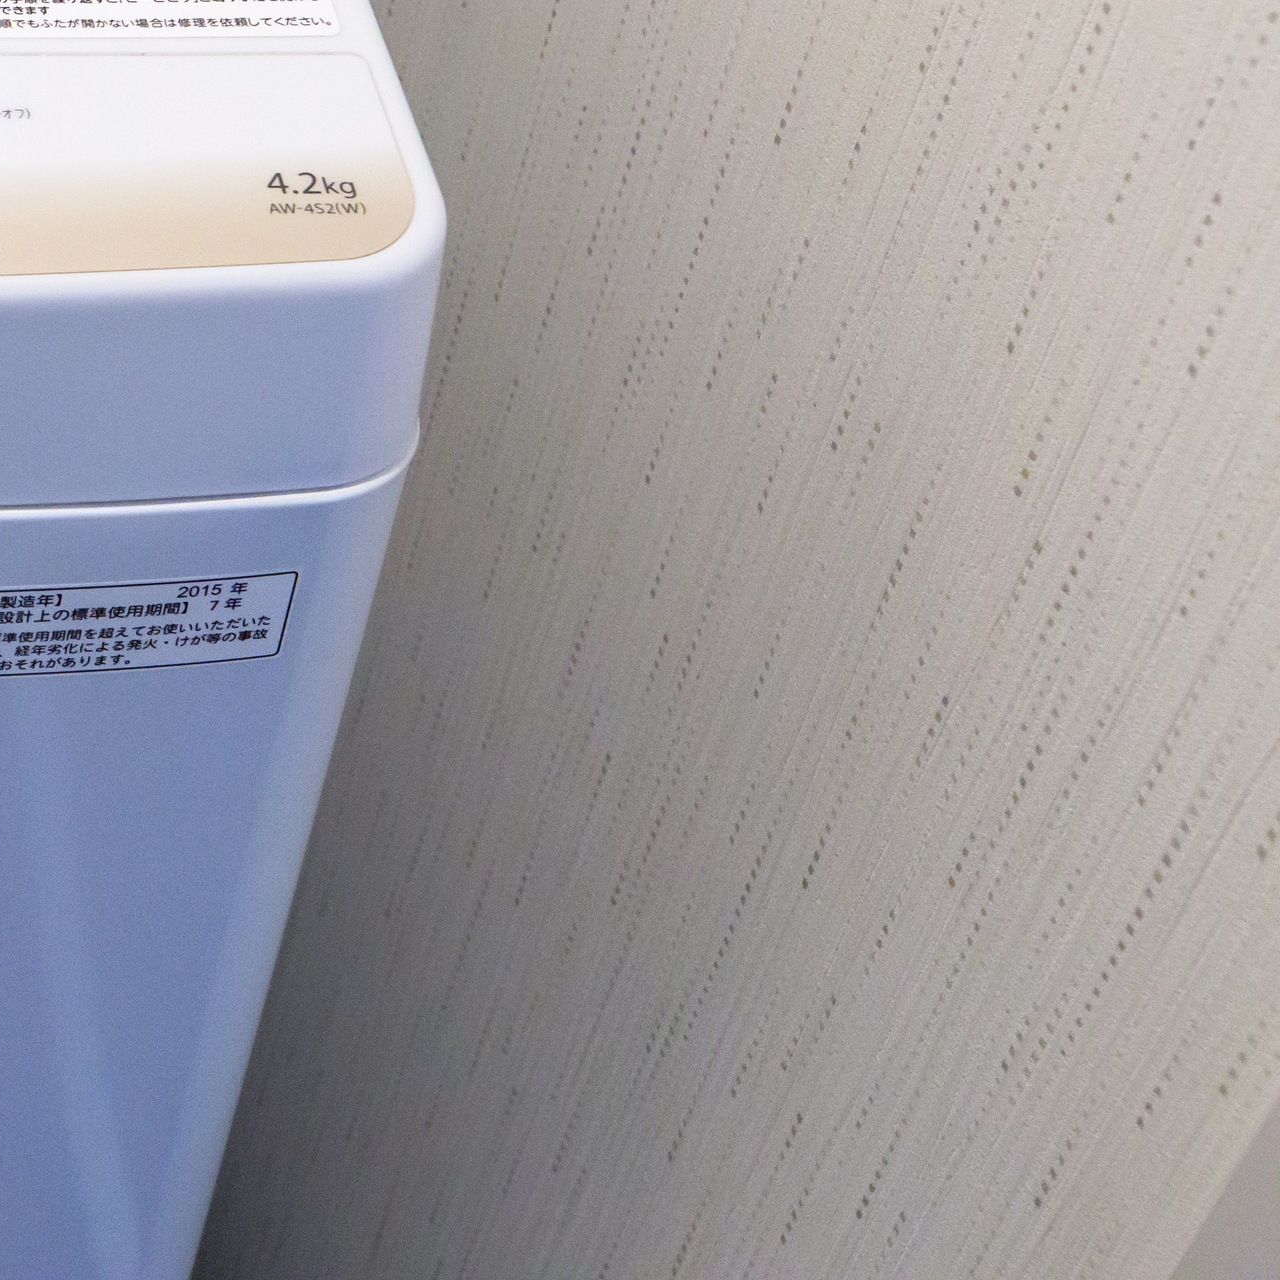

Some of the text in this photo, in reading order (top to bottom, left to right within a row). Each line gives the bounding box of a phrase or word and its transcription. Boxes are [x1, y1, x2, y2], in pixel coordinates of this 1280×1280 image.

[266, 172, 358, 199] 4.2kg
[269, 202, 367, 216] AW-4S2(W)
[176, 583, 222, 599] 2015
[230, 582, 248, 595] 年
